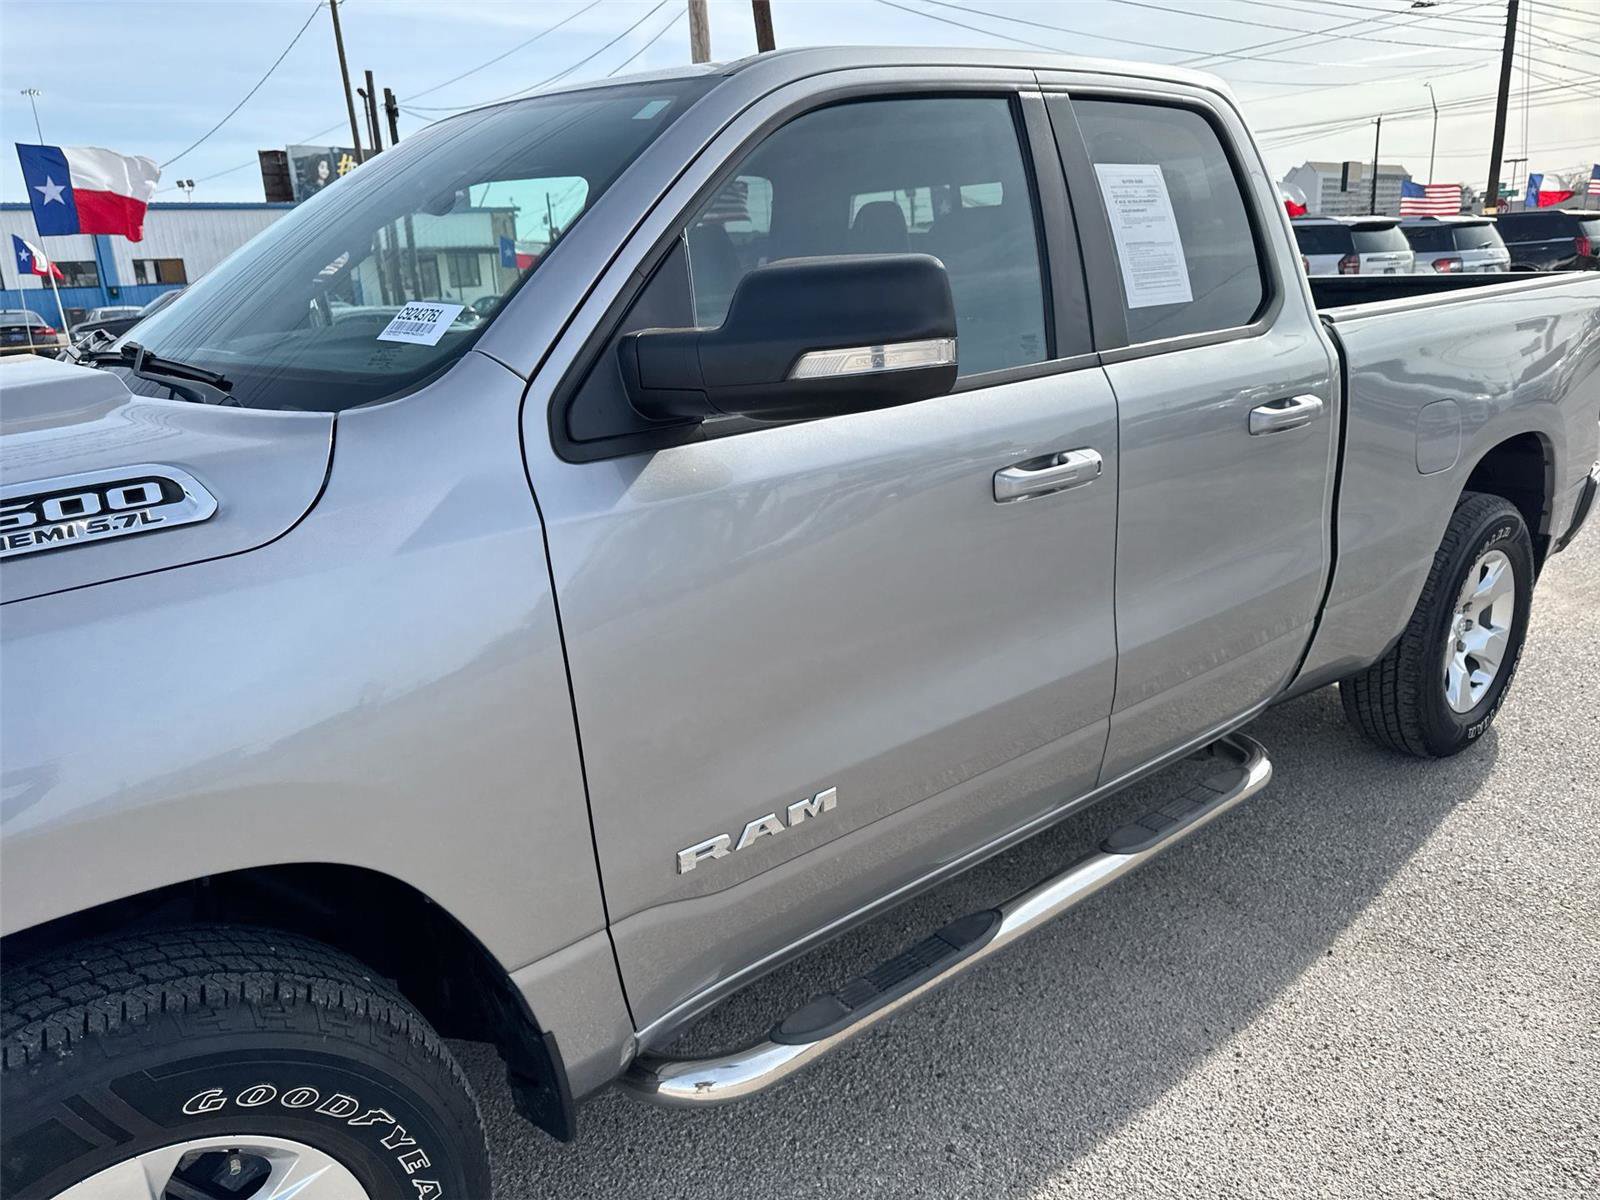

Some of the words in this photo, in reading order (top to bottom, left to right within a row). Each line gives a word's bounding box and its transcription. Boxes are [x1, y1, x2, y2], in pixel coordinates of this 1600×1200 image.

[397, 307, 444, 323] C9243761
[86, 509, 167, 535] 5.7L
[676, 786, 837, 875] RAM
